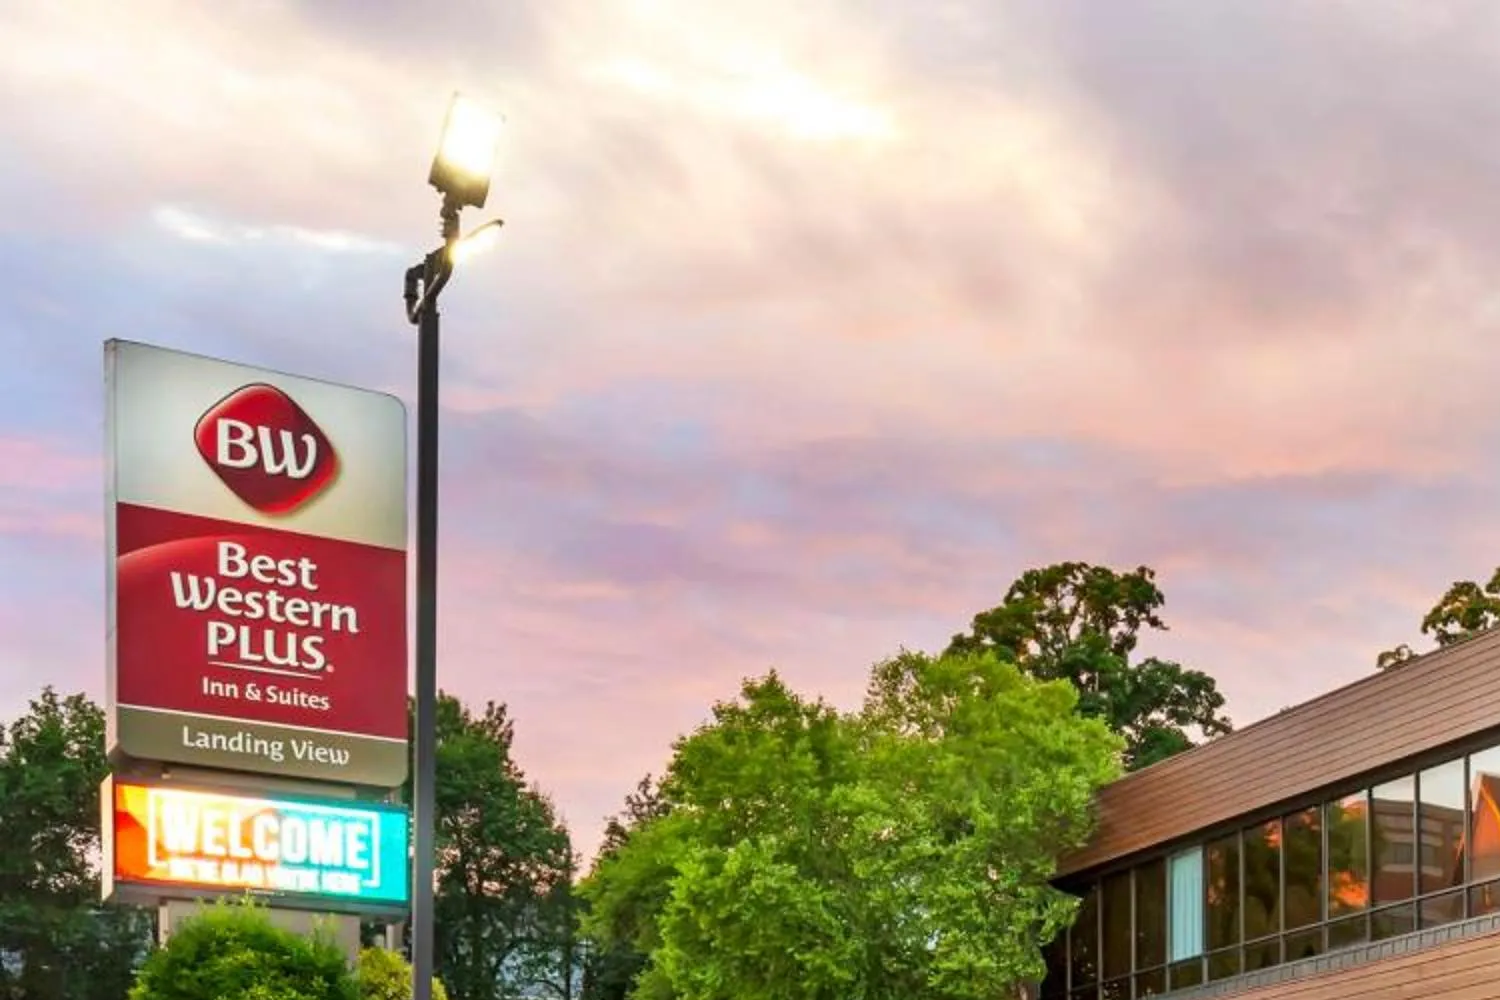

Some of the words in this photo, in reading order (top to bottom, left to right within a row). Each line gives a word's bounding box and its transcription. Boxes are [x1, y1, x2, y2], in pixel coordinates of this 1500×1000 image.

[216, 417, 317, 479] BW
[217, 541, 318, 590] Best
[170, 571, 359, 633] Western
[203, 676, 239, 699] Inn
[245, 683, 261, 701] &
[266, 685, 330, 711] Suites
[182, 726, 284, 762] Landing
[291, 740, 350, 765] View
[160, 799, 369, 870] WELCOME
